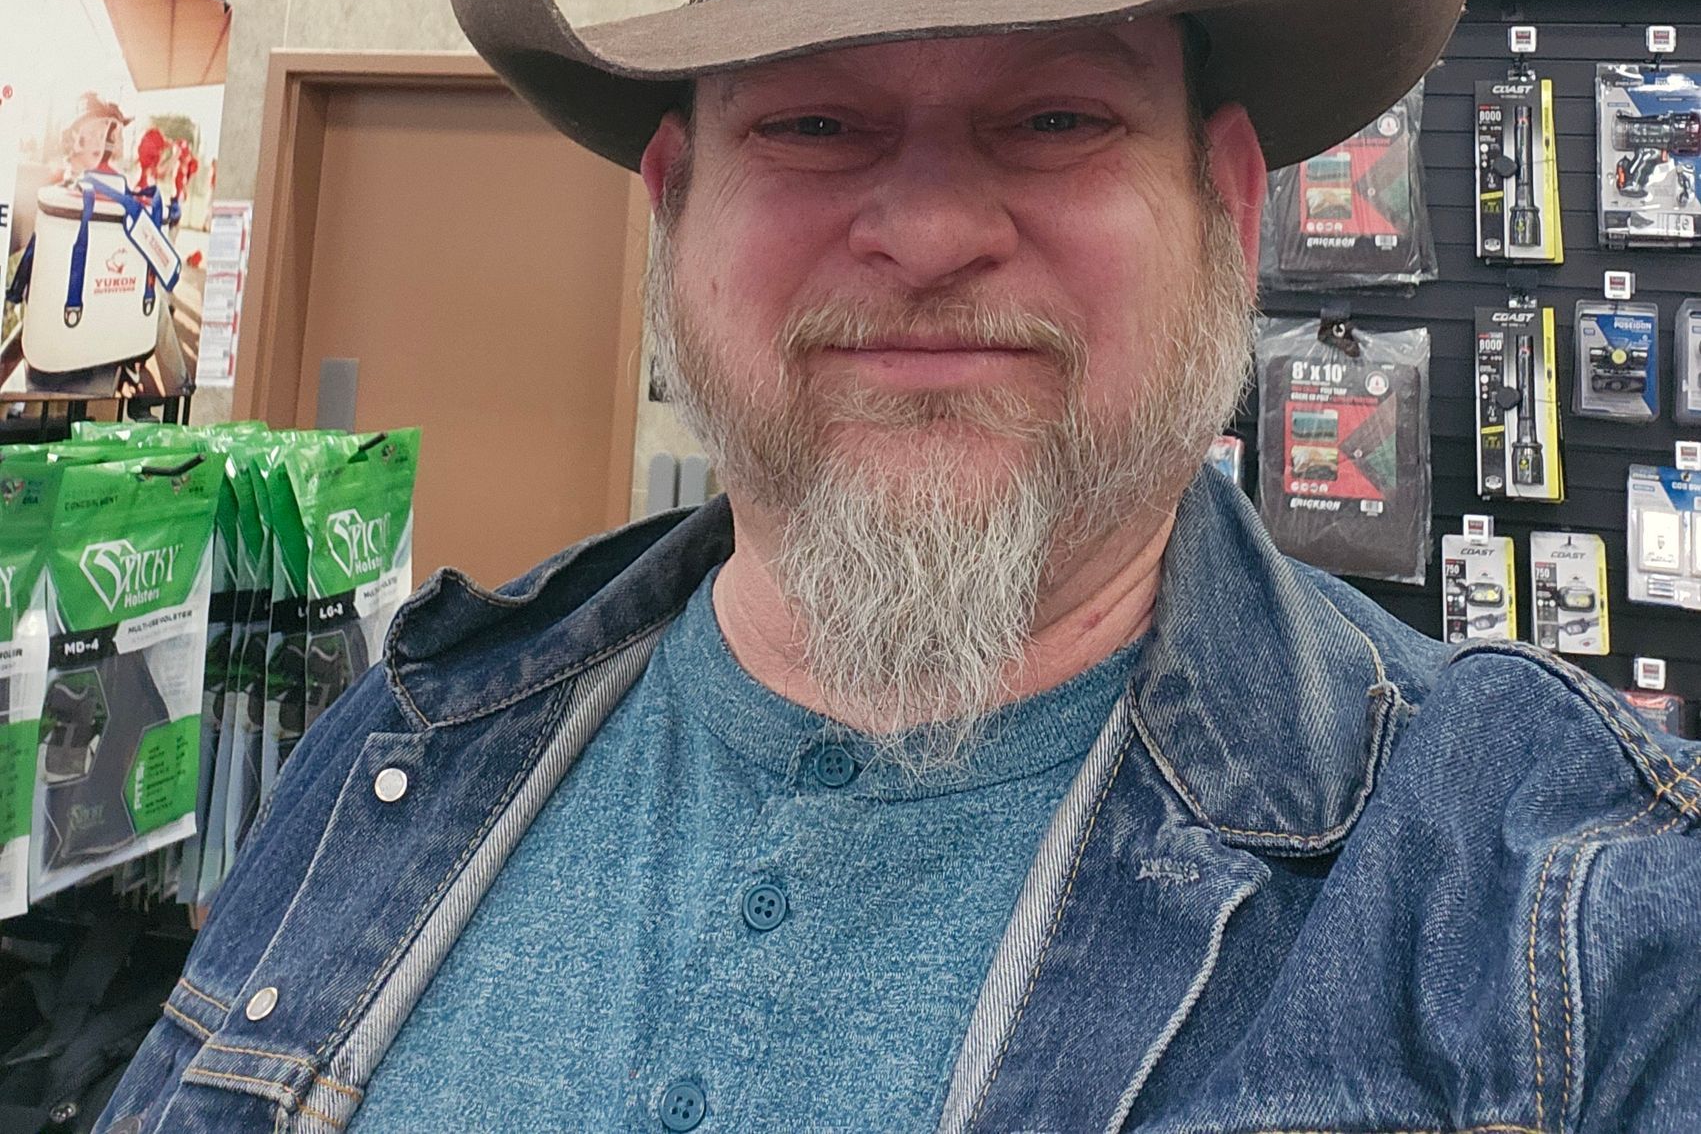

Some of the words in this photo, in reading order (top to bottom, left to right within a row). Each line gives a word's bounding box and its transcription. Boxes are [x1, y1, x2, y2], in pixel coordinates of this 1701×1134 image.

[1492, 84, 1534, 94] COAST
[95, 277, 137, 287] YUKON
[1491, 312, 1535, 323] COAST
[1479, 338, 1502, 351] 8000
[1291, 361, 1308, 380] 8'
[1322, 363, 1347, 384] 10'
[1460, 548, 1496, 557] COAST
[1550, 551, 1586, 560] COAST
[1445, 564, 1460, 576] 750
[1535, 568, 1550, 579] 750
[124, 588, 160, 608] Holsters
[63, 638, 99, 656] MD-4
